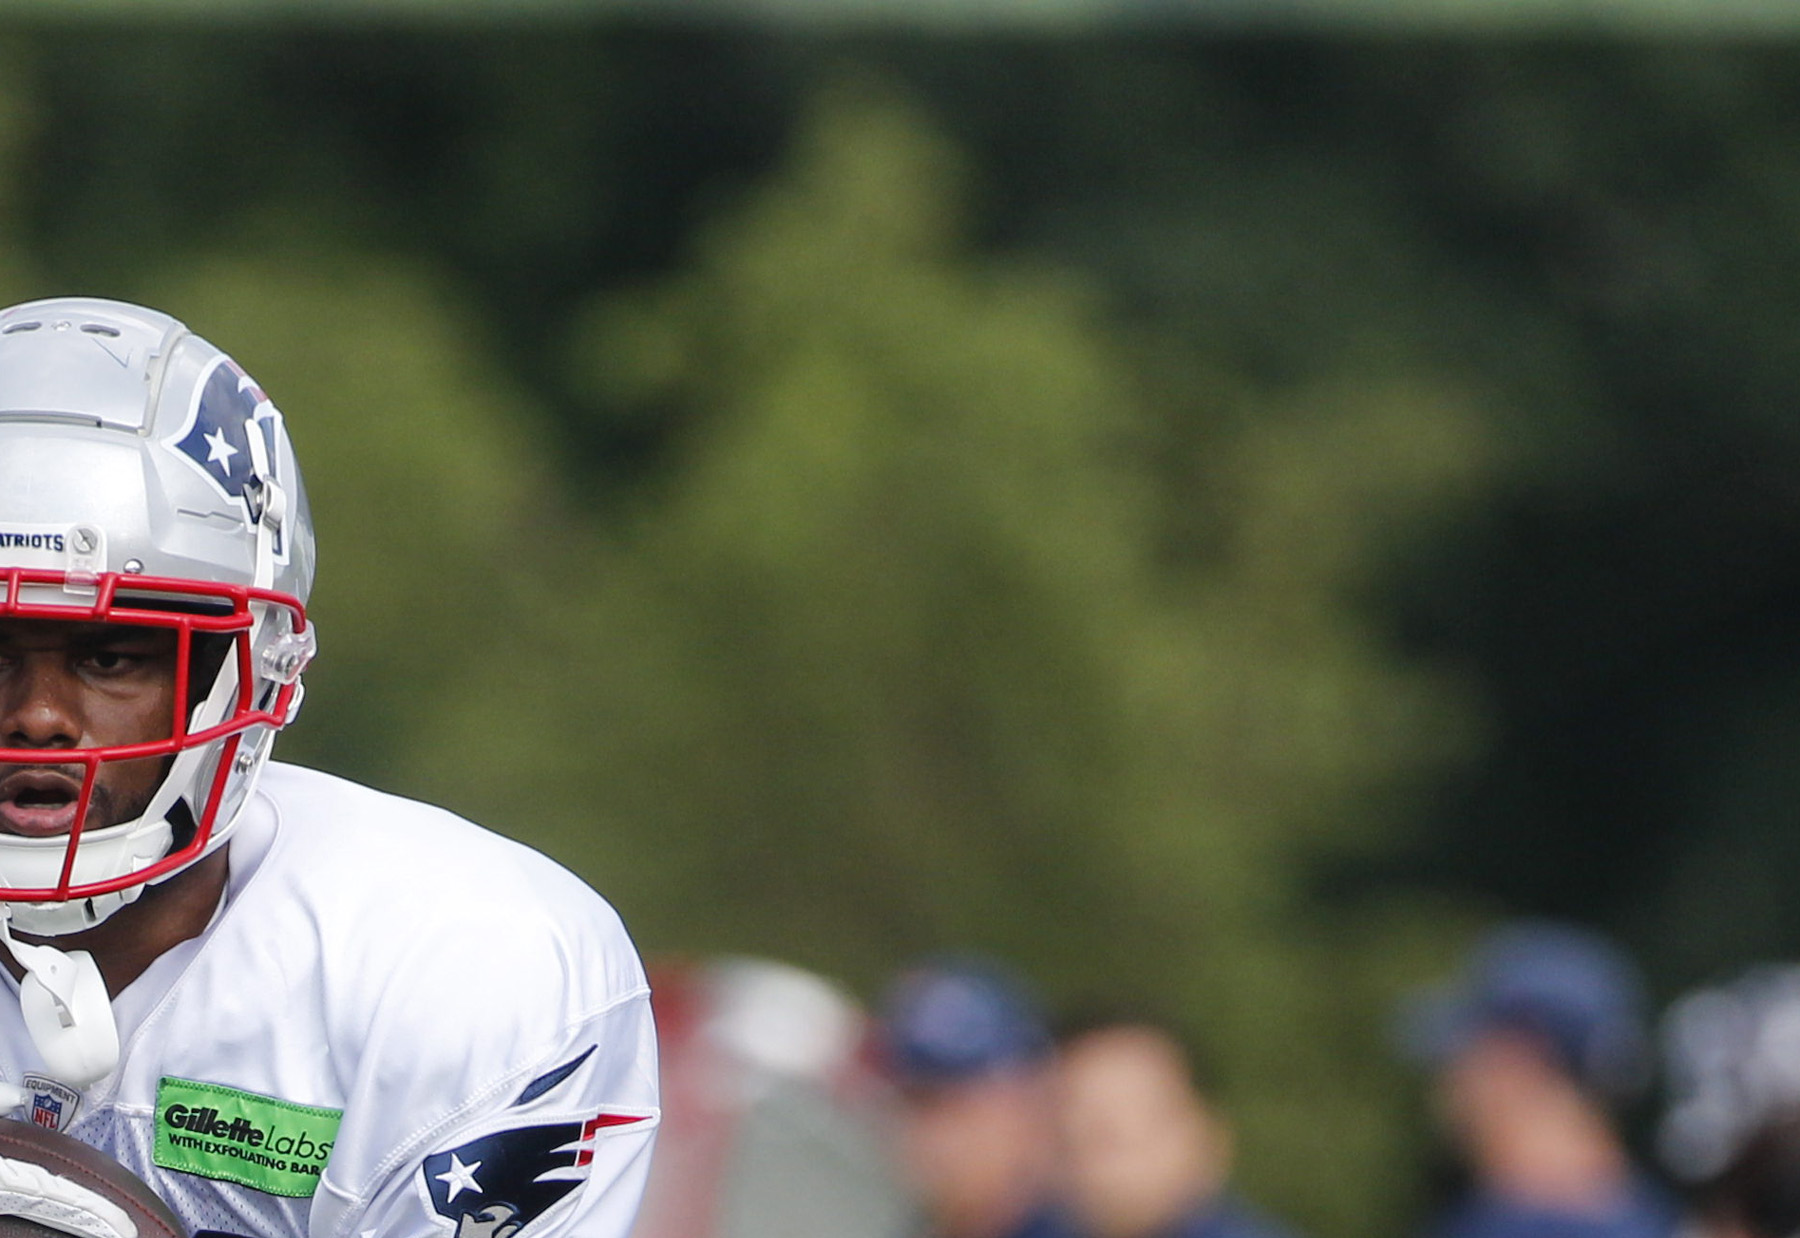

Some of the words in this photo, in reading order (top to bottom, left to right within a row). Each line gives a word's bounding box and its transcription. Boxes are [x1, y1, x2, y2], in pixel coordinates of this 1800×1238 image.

[25, 1079, 76, 1105] EQUIPMENT
[34, 1107, 58, 1129] NFL
[168, 1132, 203, 1151] WITH
[204, 1141, 287, 1170] EXFOLIATING
[290, 1161, 321, 1176] BAR
